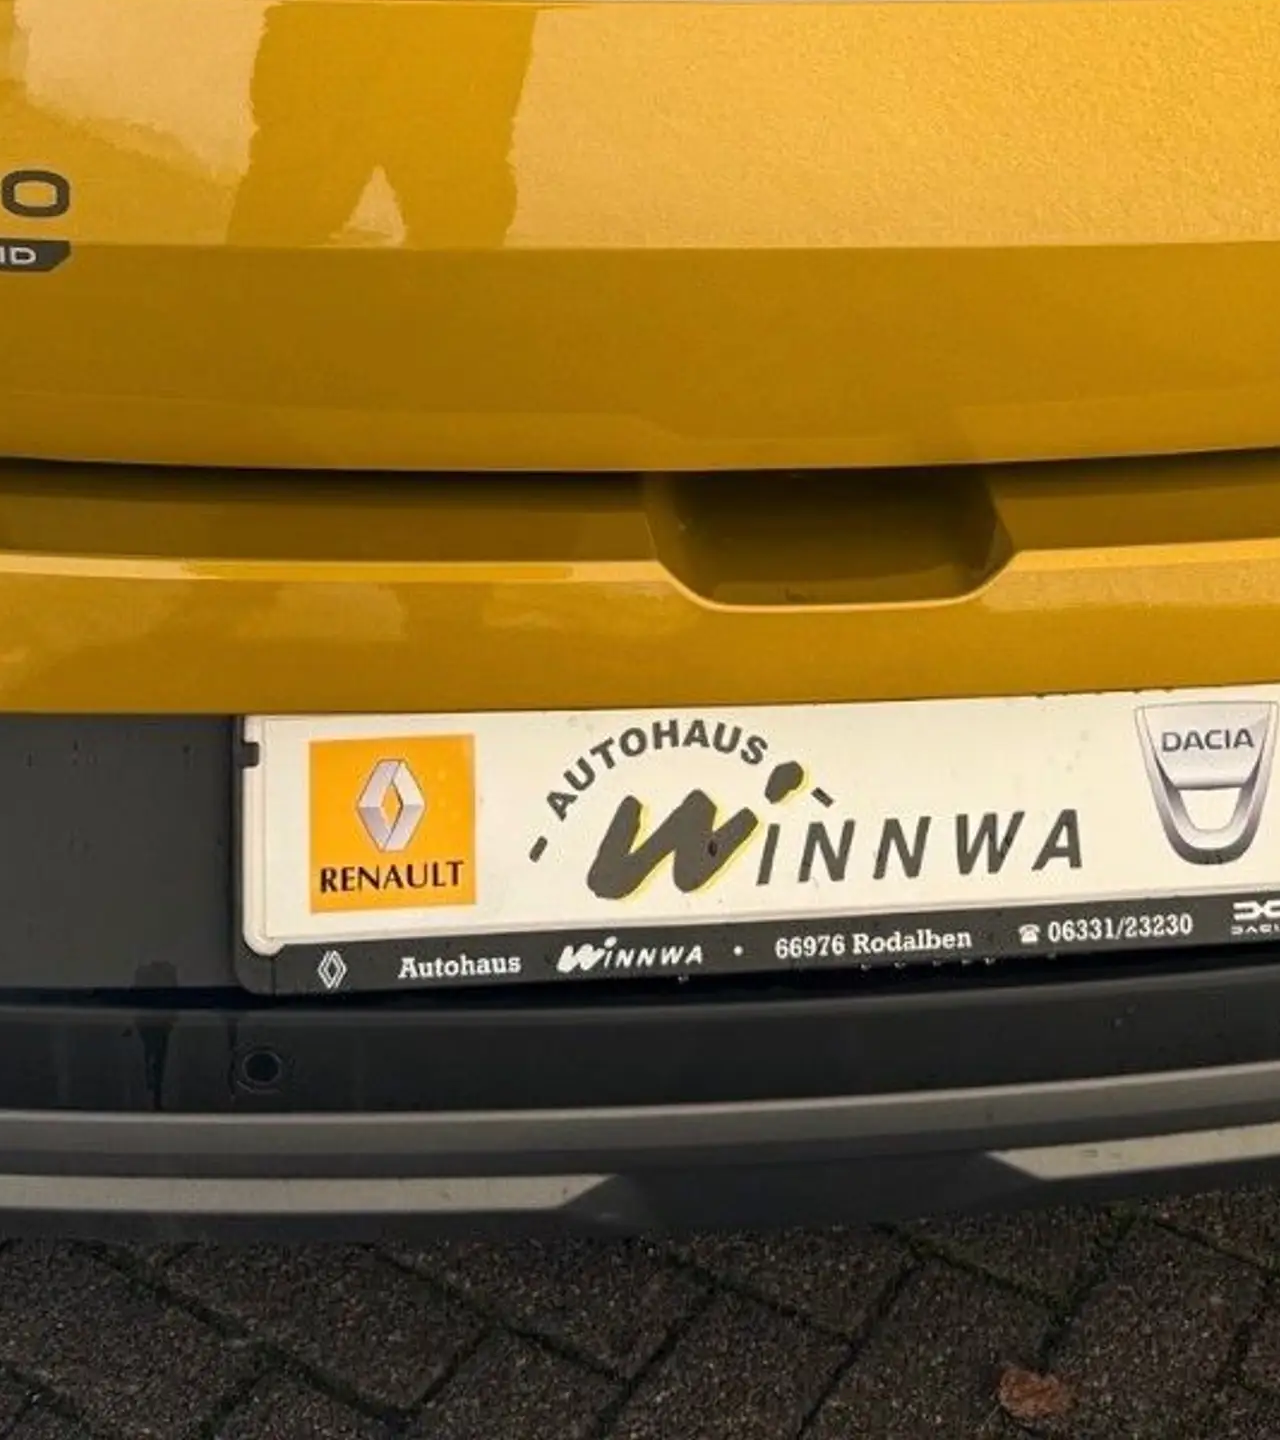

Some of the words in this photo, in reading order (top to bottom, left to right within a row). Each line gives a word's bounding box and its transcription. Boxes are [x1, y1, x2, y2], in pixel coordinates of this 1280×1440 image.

[1161, 728, 1254, 752] DACIA
[546, 718, 768, 822] AUTOHAUS
[320, 860, 464, 893] RENAULT
[398, 953, 521, 979] Autohaus
[775, 932, 846, 959] 66976
[852, 928, 972, 954] Rodalben
[1048, 913, 1193, 942] 06331/23230
